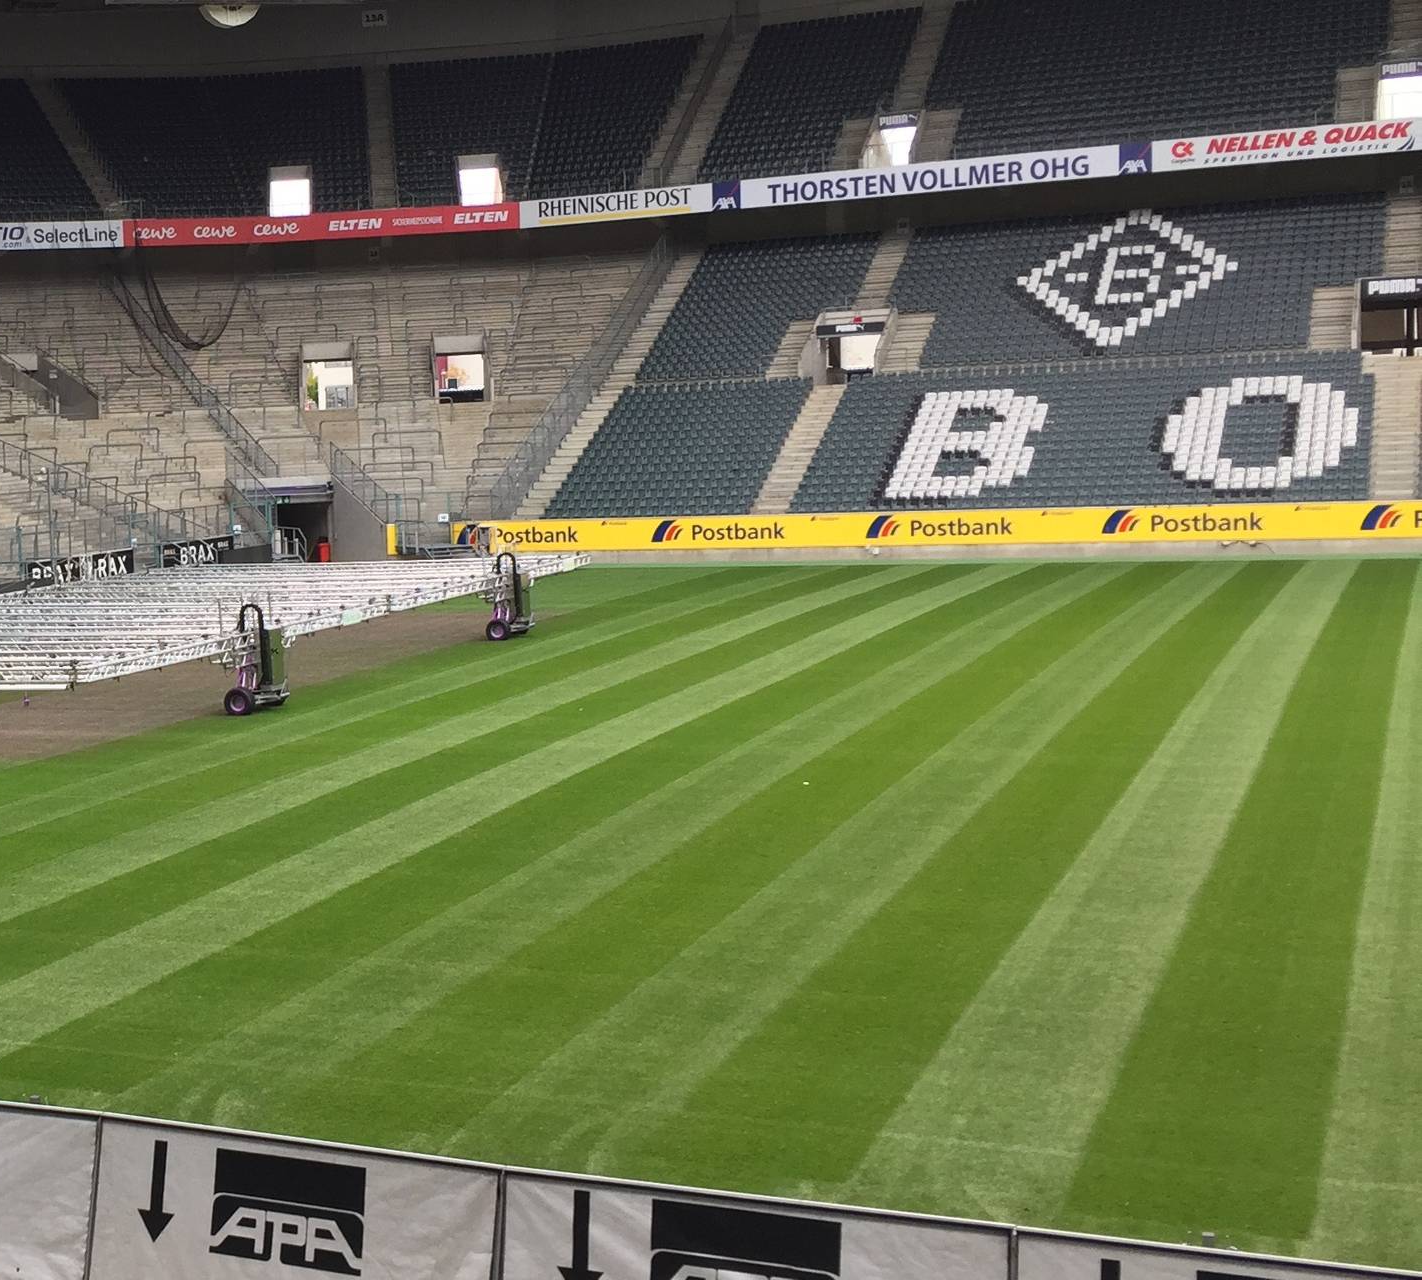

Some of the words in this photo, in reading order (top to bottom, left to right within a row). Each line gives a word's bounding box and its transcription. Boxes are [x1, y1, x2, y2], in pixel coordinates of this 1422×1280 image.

[1207, 132, 1295, 155] NELLEN
[1298, 130, 1318, 147] &
[1324, 121, 1412, 145] QUACK
[1203, 152, 1278, 165] SPEDITION
[1287, 149, 1313, 157] UND
[1323, 143, 1389, 155] LOGISTIK
[1119, 159, 1147, 173] AXA
[767, 174, 896, 204] THORSTEN
[902, 161, 1023, 196] VOLLMER
[1030, 154, 1090, 181] OHG
[538, 192, 639, 219] RHEINISCHE
[644, 187, 692, 208] POST
[713, 195, 736, 209] AXA
[133, 226, 178, 240] cewe
[193, 224, 237, 239] cewe
[253, 221, 300, 238] cewe
[328, 217, 382, 233] ELTEN
[453, 210, 509, 225] ELTEN
[33, 228, 118, 244] SelectLine
[691, 523, 785, 541] Postbank
[909, 516, 1012, 537] Postbank
[1150, 512, 1263, 532] Postbank
[209, 1206, 363, 1270] APA
